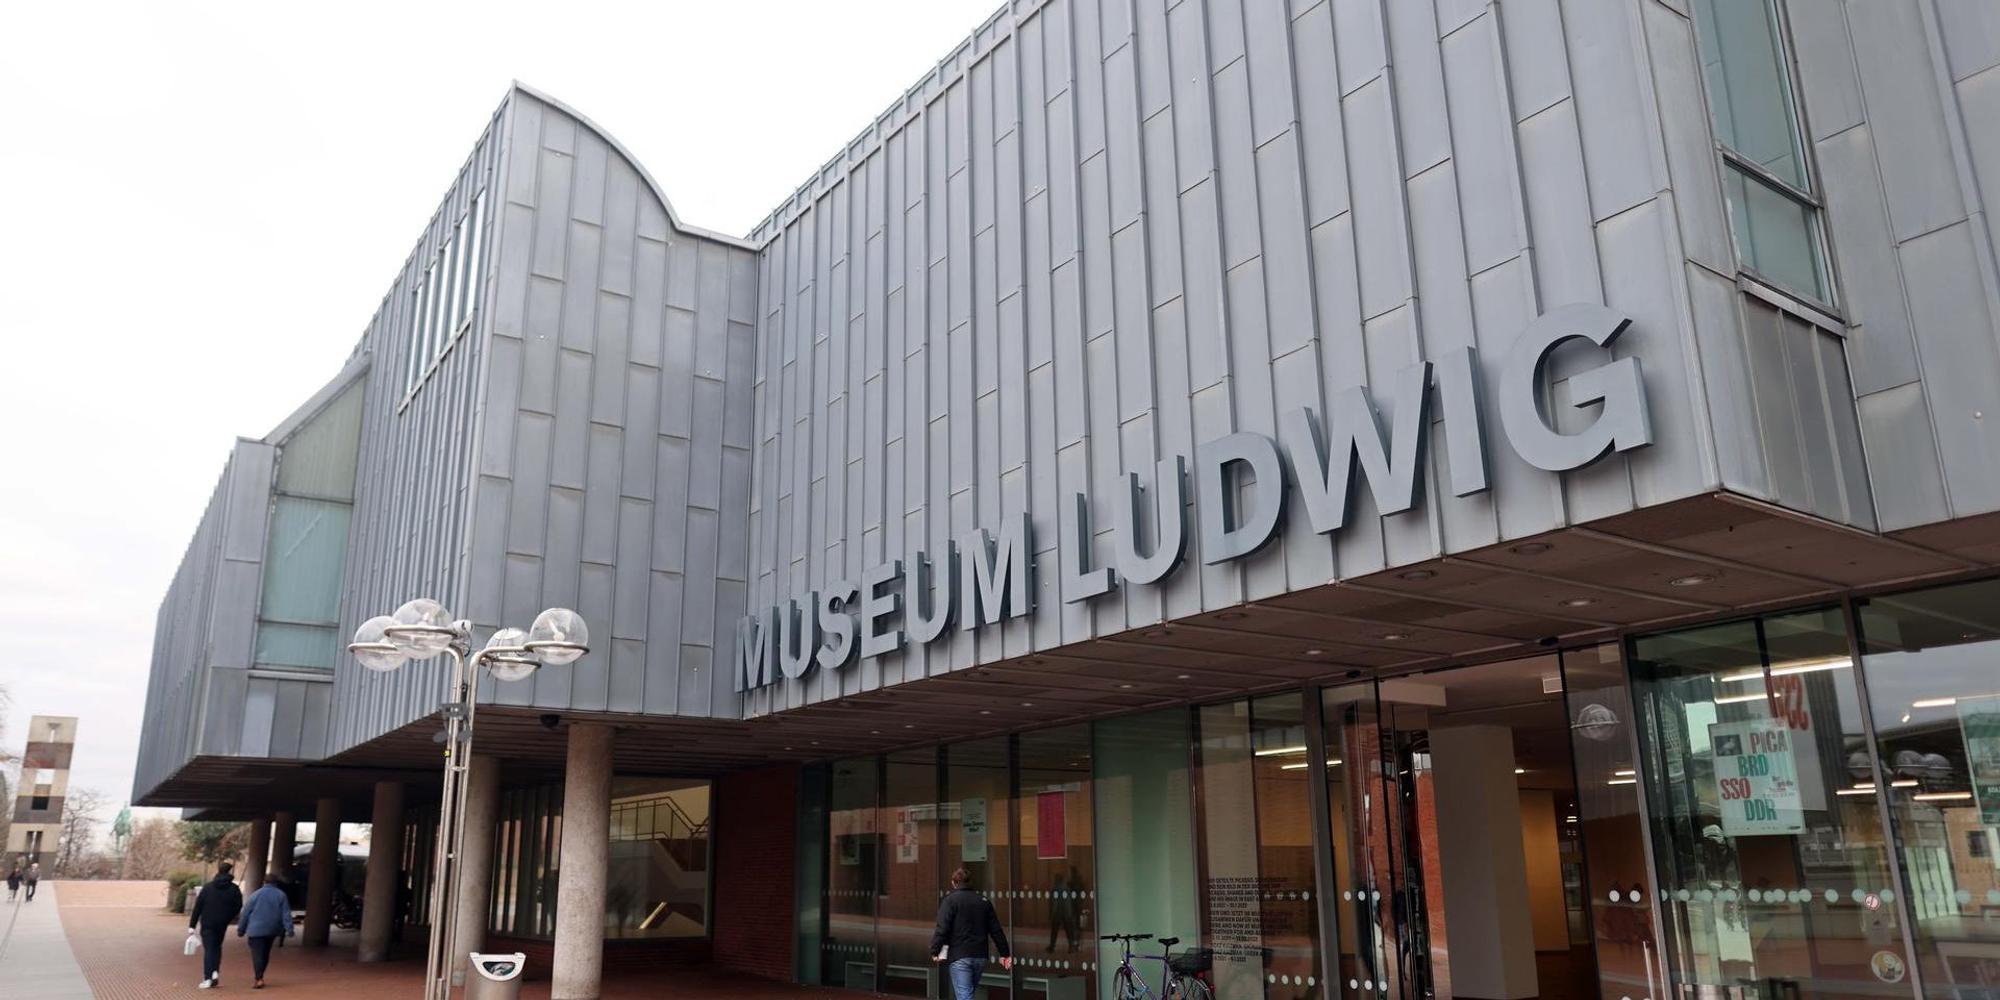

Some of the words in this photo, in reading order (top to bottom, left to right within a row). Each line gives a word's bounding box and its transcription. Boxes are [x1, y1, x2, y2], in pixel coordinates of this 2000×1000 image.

[735, 512, 1034, 693] MUSEUM
[1062, 302, 1655, 605] LUDWIG
[1749, 730, 1788, 754] PICA
[1737, 754, 1769, 777] BRD
[1720, 777, 1751, 800] SSO
[1743, 799, 1777, 822] DDR
